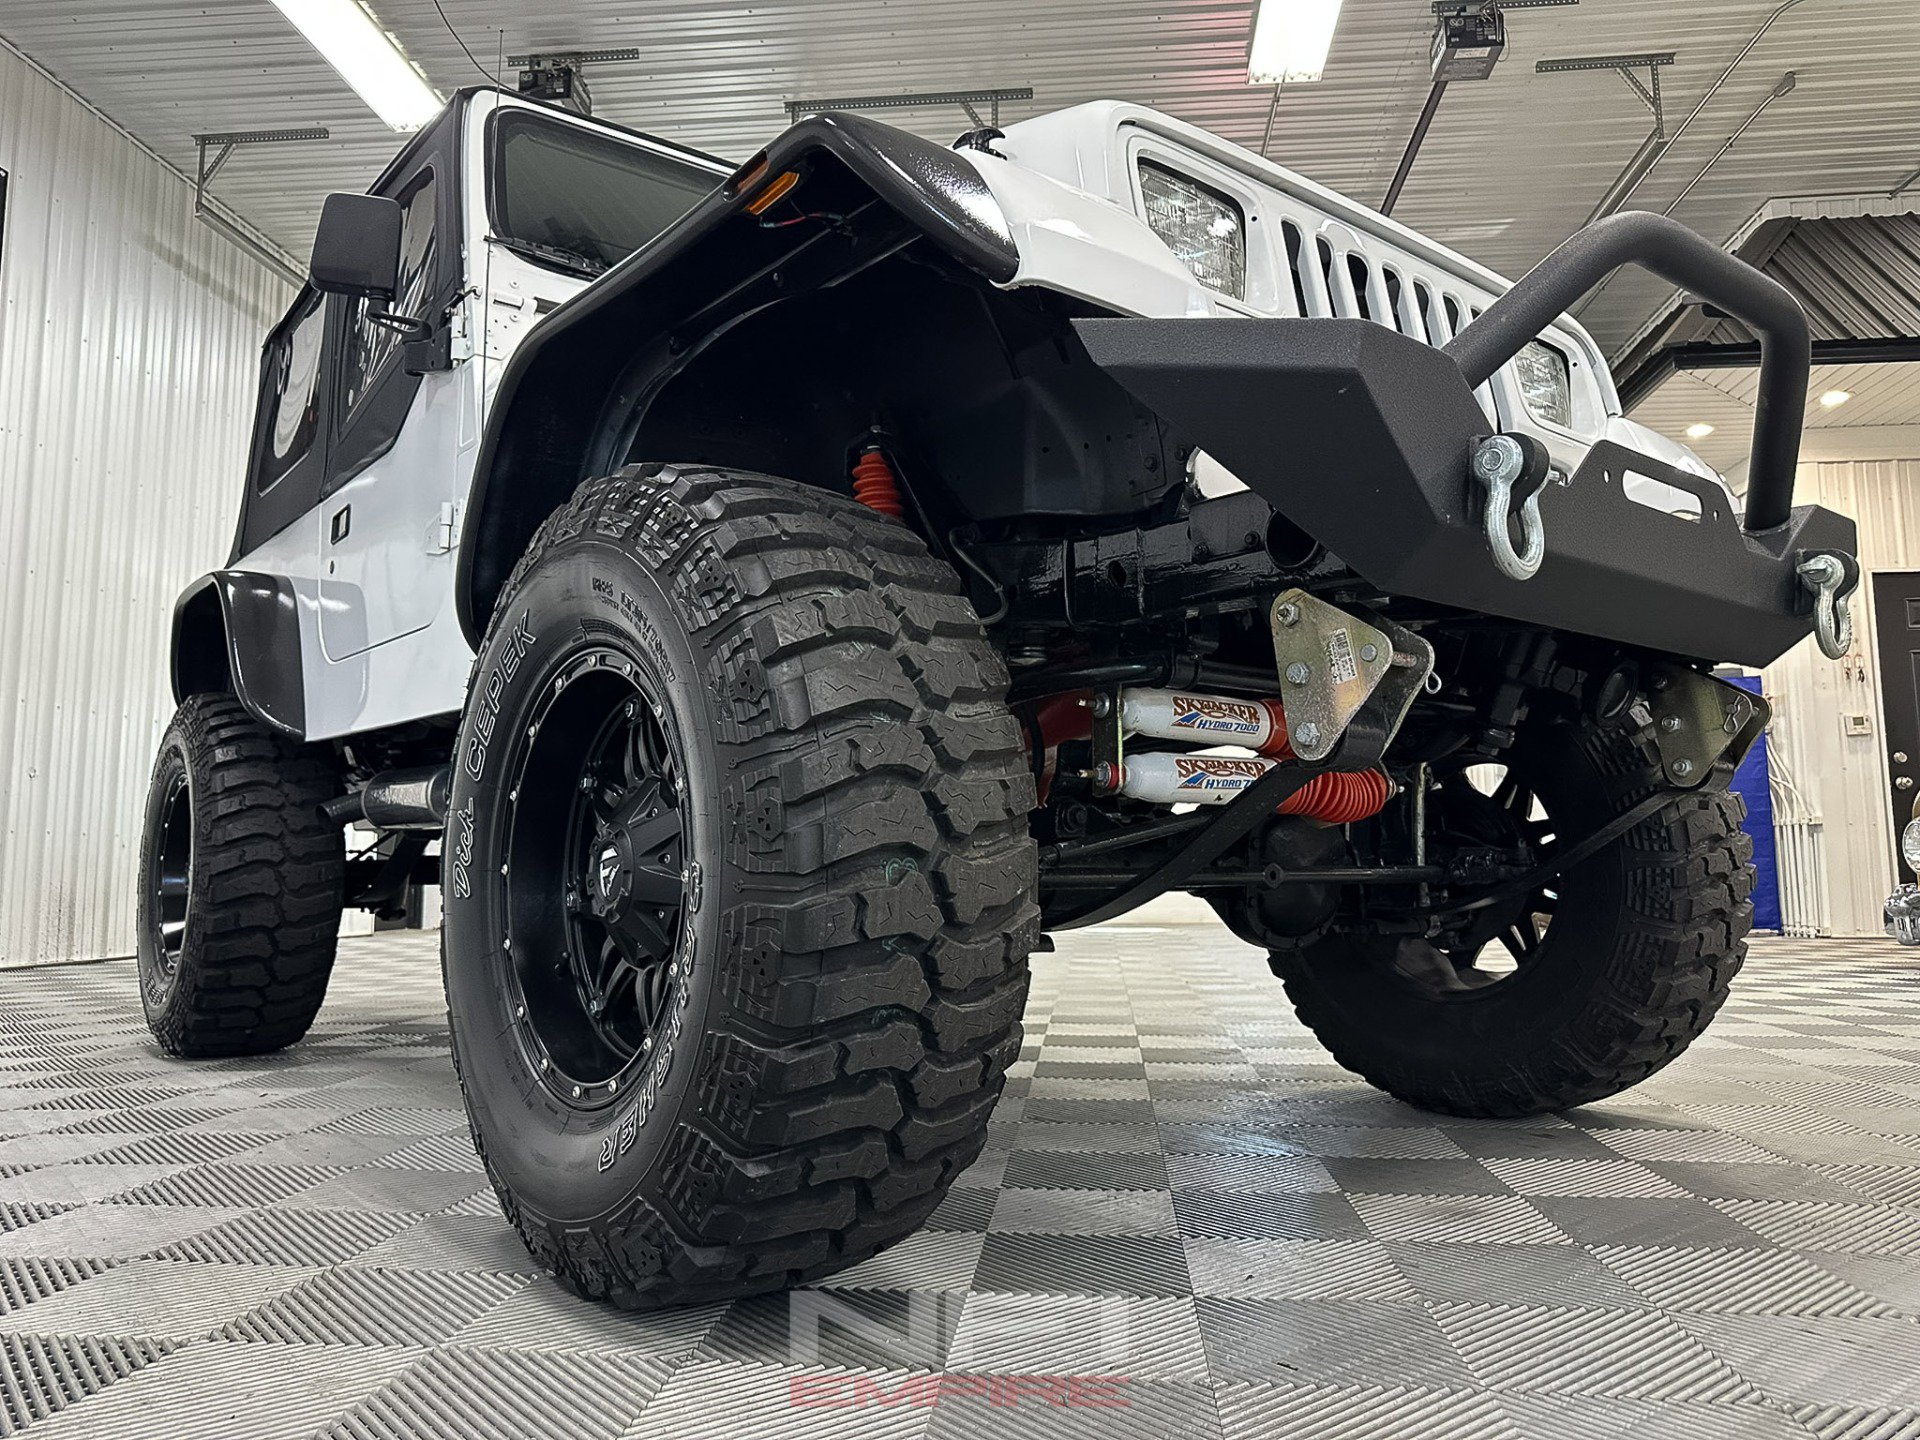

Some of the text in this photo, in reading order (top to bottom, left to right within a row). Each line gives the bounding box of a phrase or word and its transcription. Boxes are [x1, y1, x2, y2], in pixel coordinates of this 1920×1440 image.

[1172, 695, 1261, 724] SKYJACKER
[1197, 719, 1260, 733] HYDRO 7000
[453, 608, 537, 900] Dick CEPEK
[1175, 758, 1267, 780] SKYJACKER
[1204, 778, 1242, 790] HYDRO
[597, 860, 703, 1174] CRUSHER
